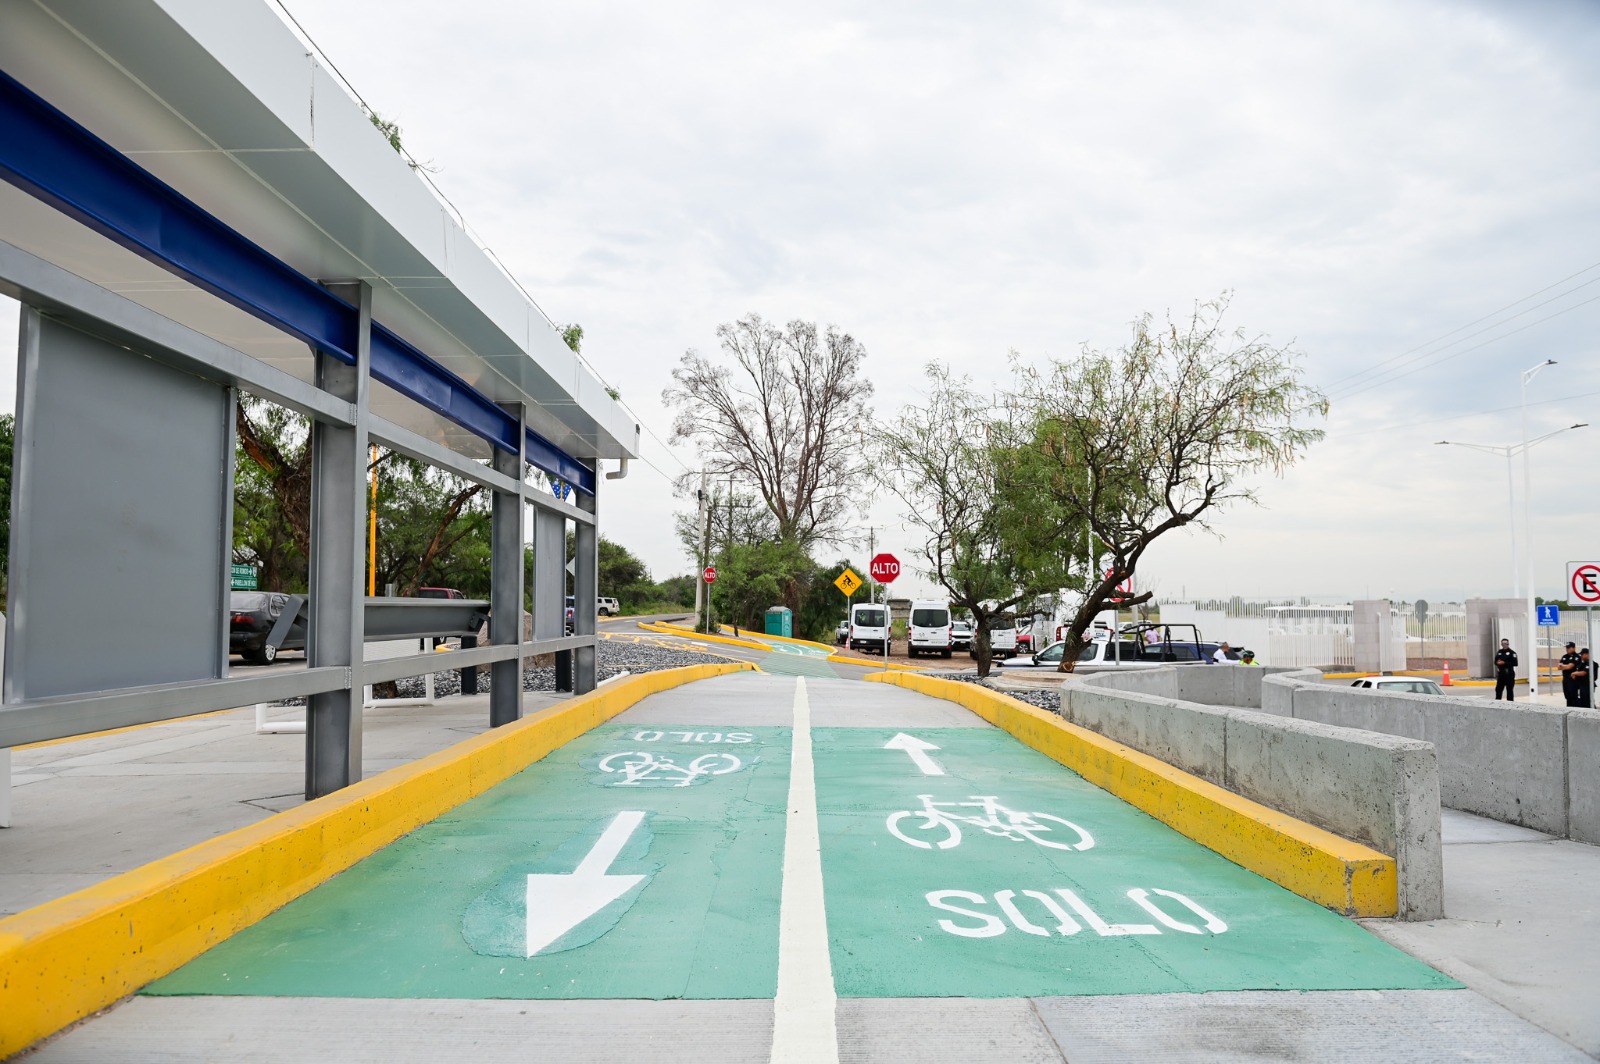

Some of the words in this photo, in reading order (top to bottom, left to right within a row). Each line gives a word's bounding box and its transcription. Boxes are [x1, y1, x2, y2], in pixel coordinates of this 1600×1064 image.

[872, 562, 898, 574] ALTO
[633, 730, 754, 744] SOLO
[925, 888, 1229, 938] SOLO
